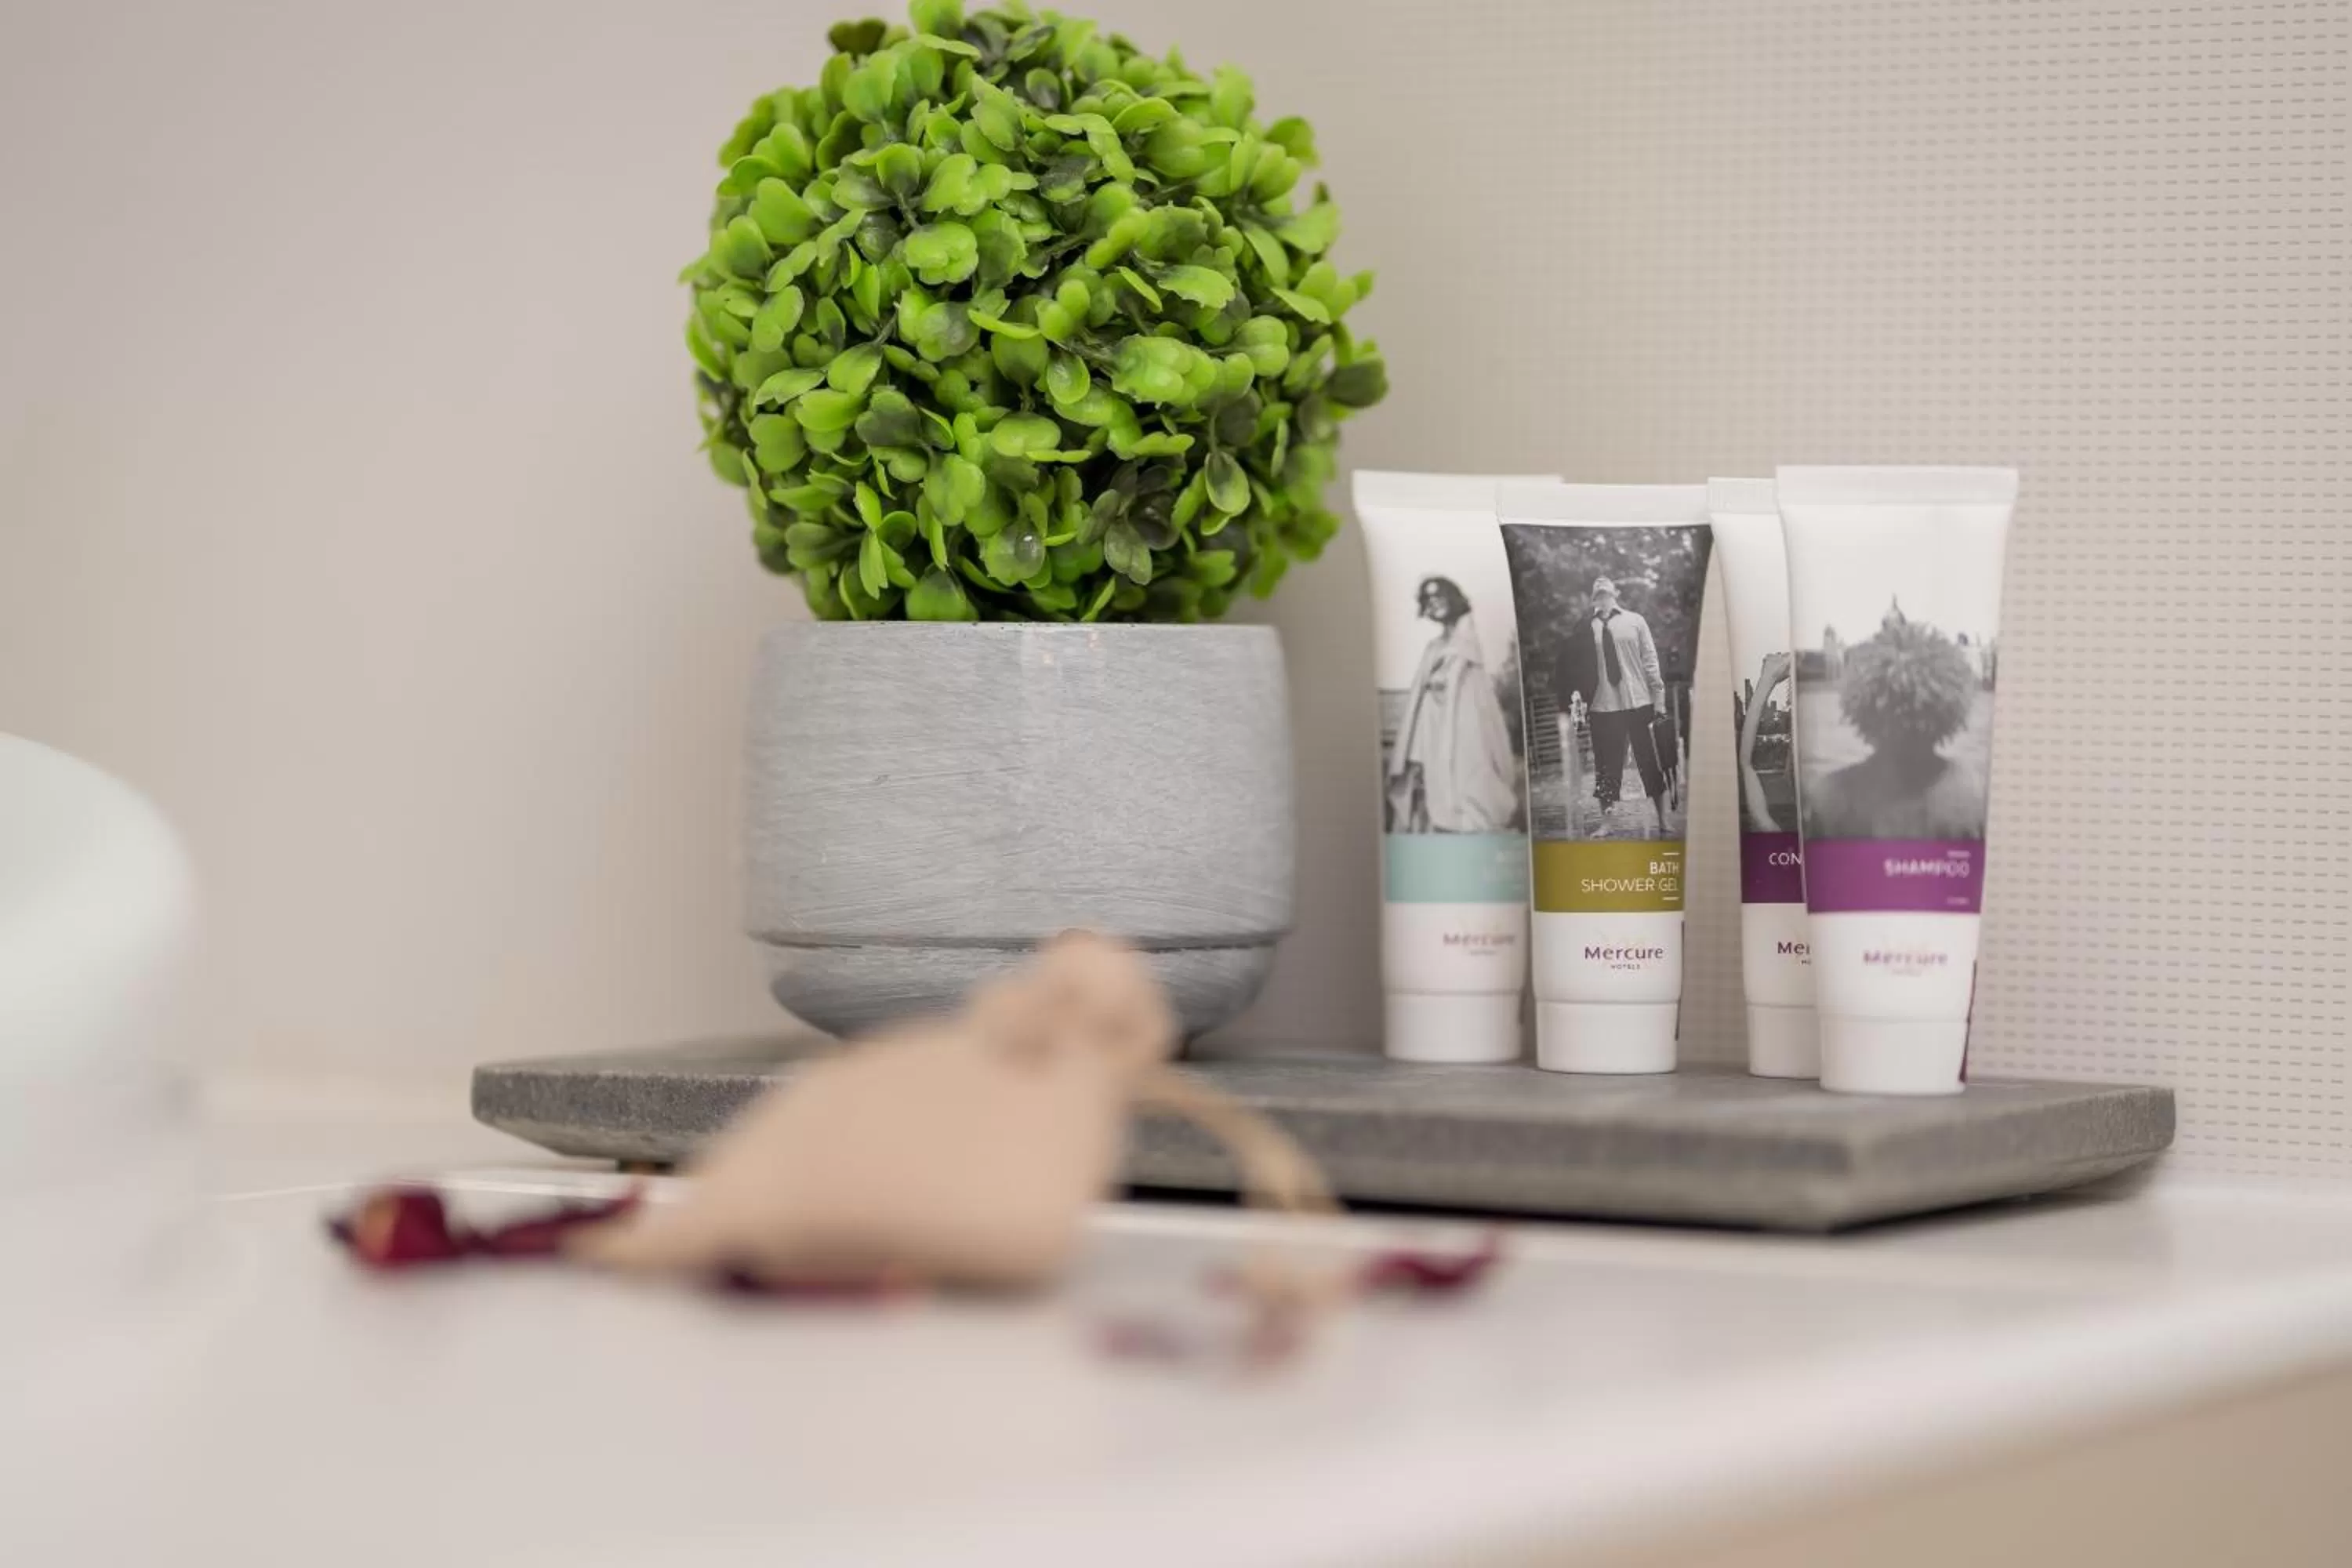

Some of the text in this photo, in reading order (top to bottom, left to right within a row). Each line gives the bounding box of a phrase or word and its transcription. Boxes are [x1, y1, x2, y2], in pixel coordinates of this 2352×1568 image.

[1649, 862, 1679, 875] BATH
[1884, 858, 1970, 877] SHAMPOO
[1581, 877, 1679, 892] SHOWER GEL
[1584, 946, 1664, 960] Mercure
[1863, 949, 1948, 966] Mercure
